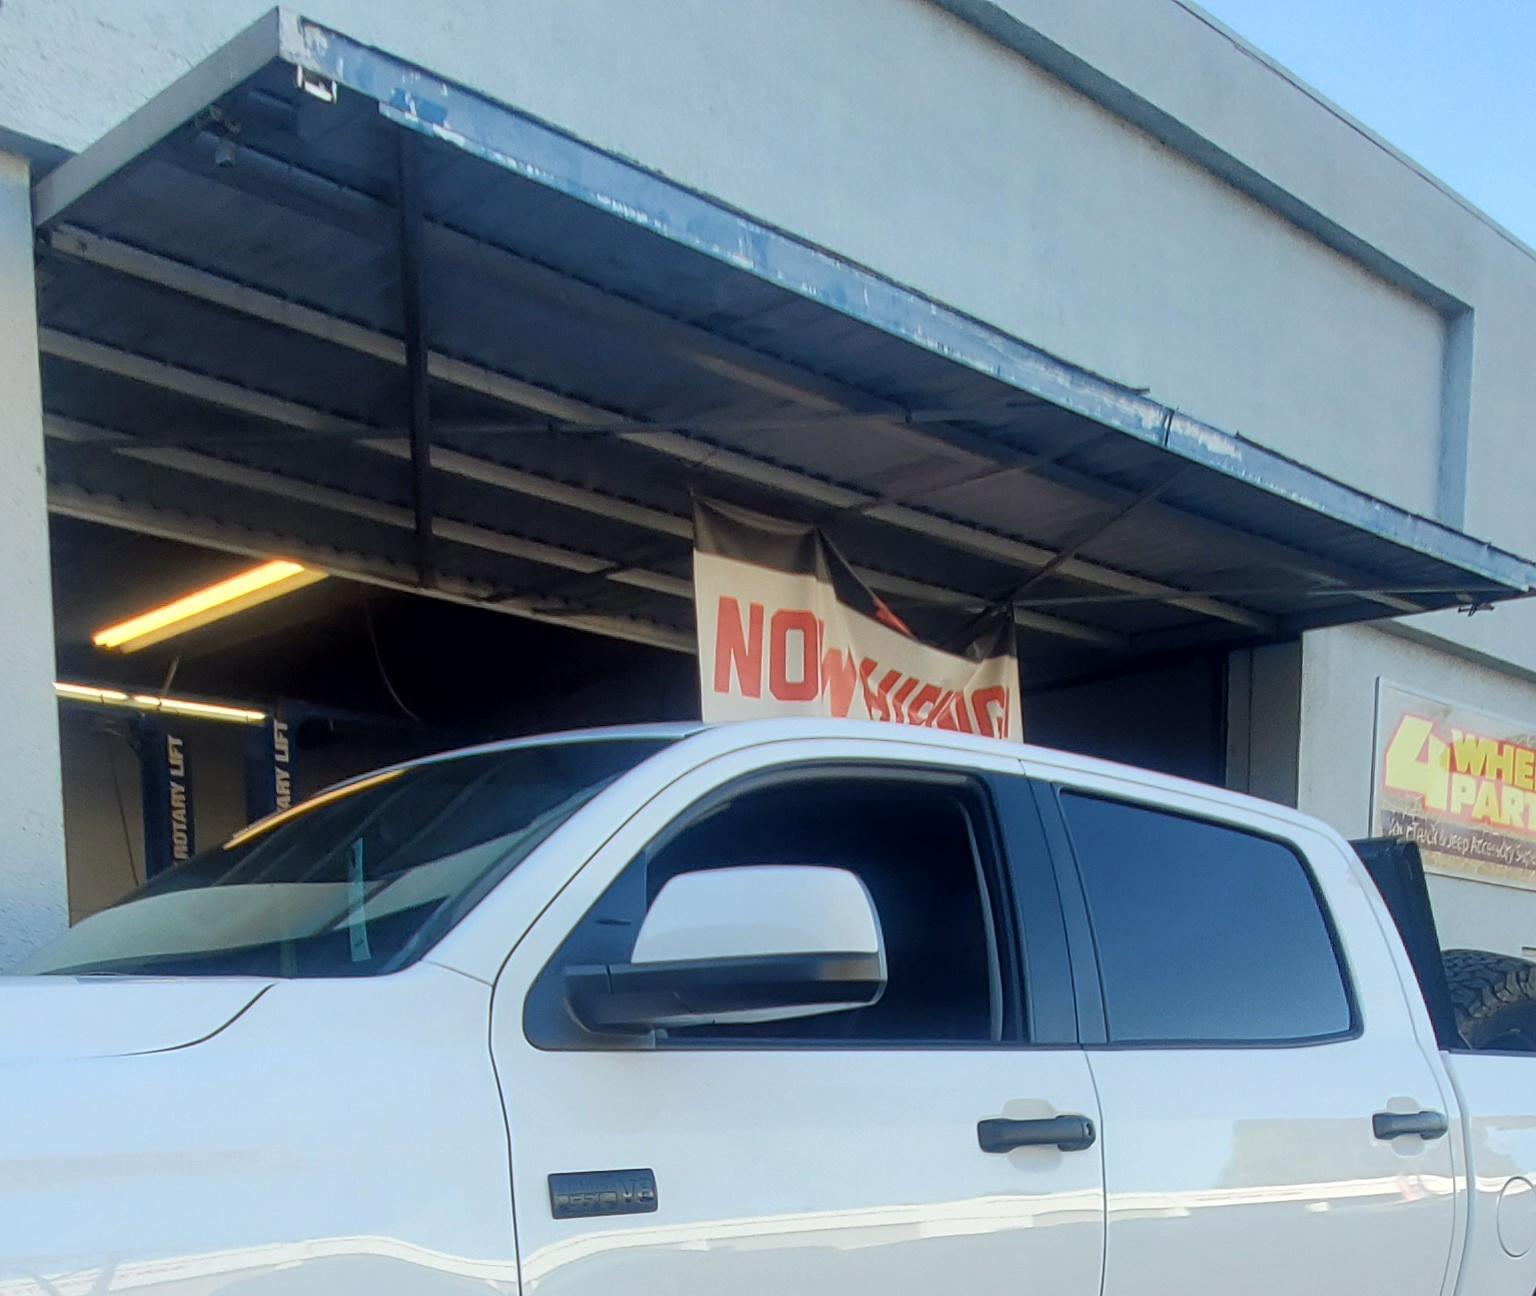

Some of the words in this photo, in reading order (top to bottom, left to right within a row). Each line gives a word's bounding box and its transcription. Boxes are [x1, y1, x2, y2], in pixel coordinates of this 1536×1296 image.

[713, 596, 858, 718] NOW
[167, 734, 185, 777] LIFT
[273, 719, 290, 763] LIFT
[1384, 714, 1450, 811] 4
[169, 781, 189, 860] ROTARY
